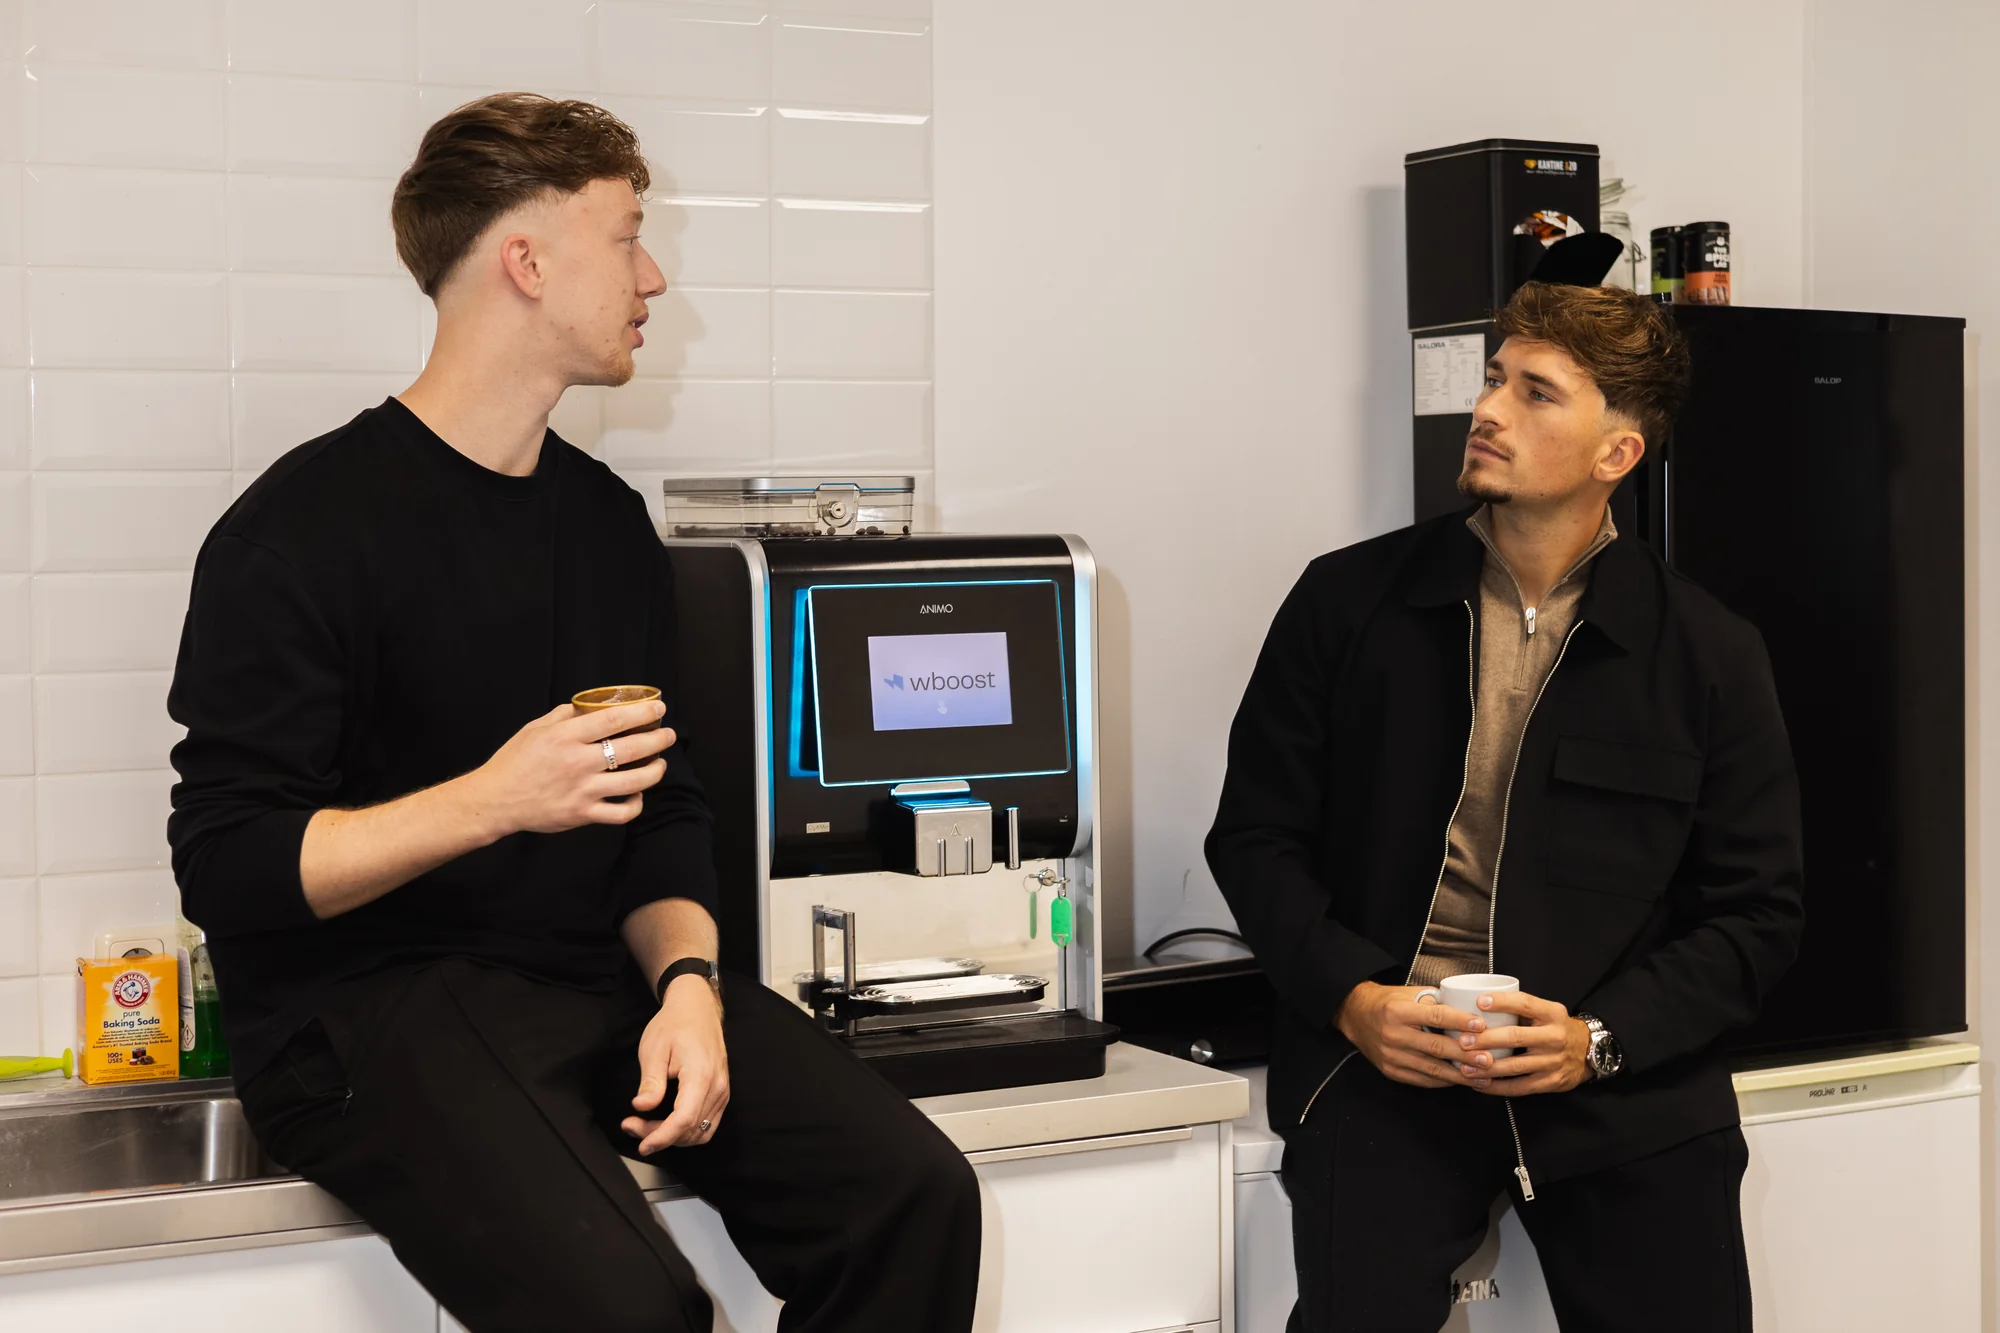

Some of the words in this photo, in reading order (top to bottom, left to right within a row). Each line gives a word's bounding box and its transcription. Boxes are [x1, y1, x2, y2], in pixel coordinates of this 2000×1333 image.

[1705, 253, 1730, 262] SPIC
[1417, 341, 1445, 350] SALORA
[919, 603, 954, 614] ANIMO
[910, 671, 996, 692] wboost
[127, 974, 149, 993] HAMMER
[123, 1010, 141, 1019] pure
[103, 1020, 134, 1028] Baking
[137, 1017, 160, 1025] Soda
